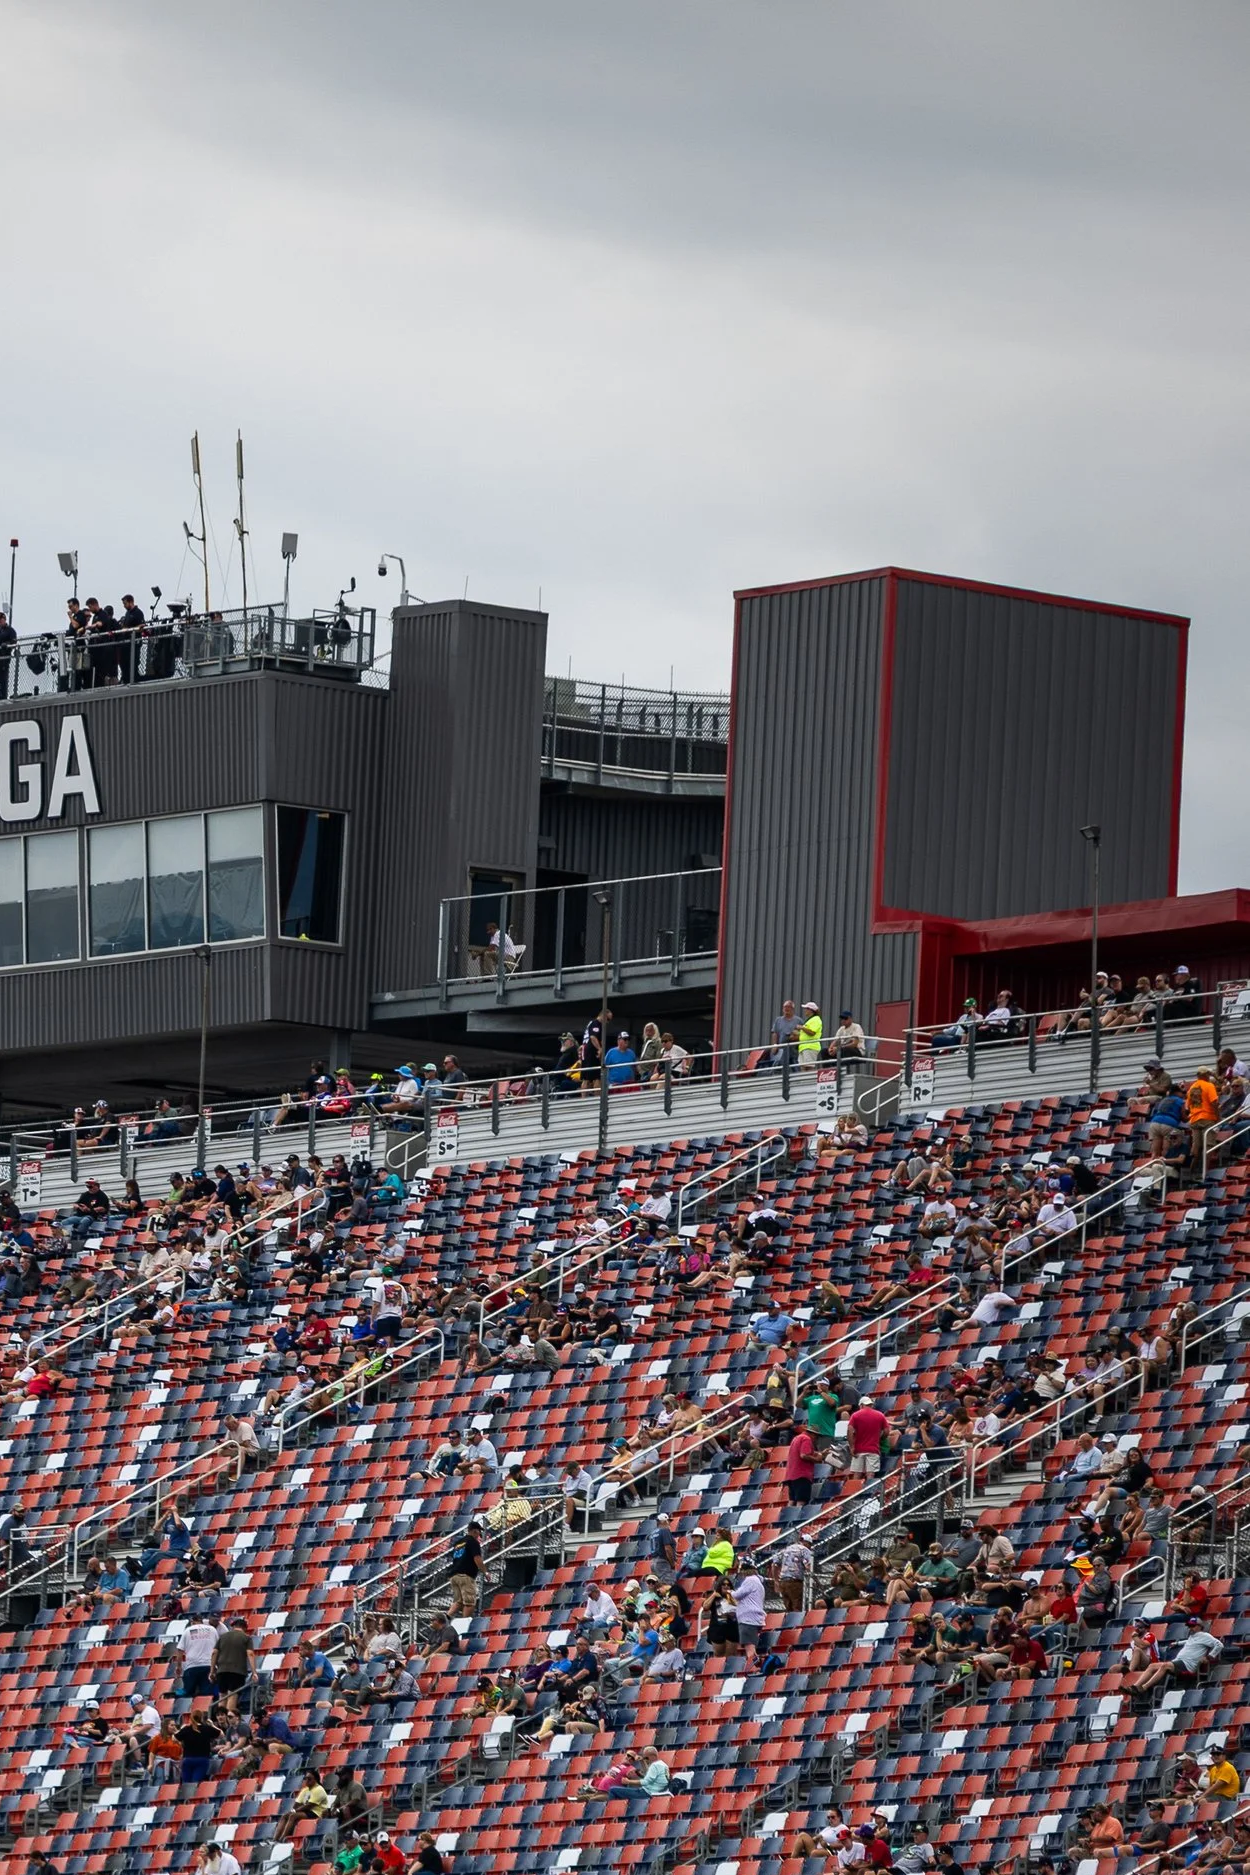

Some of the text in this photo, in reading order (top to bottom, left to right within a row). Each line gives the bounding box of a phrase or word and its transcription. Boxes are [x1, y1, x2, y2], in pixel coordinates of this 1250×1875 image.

[827, 1097, 835, 1111] S
[439, 1141, 446, 1155] S
[22, 1188, 29, 1202] T
